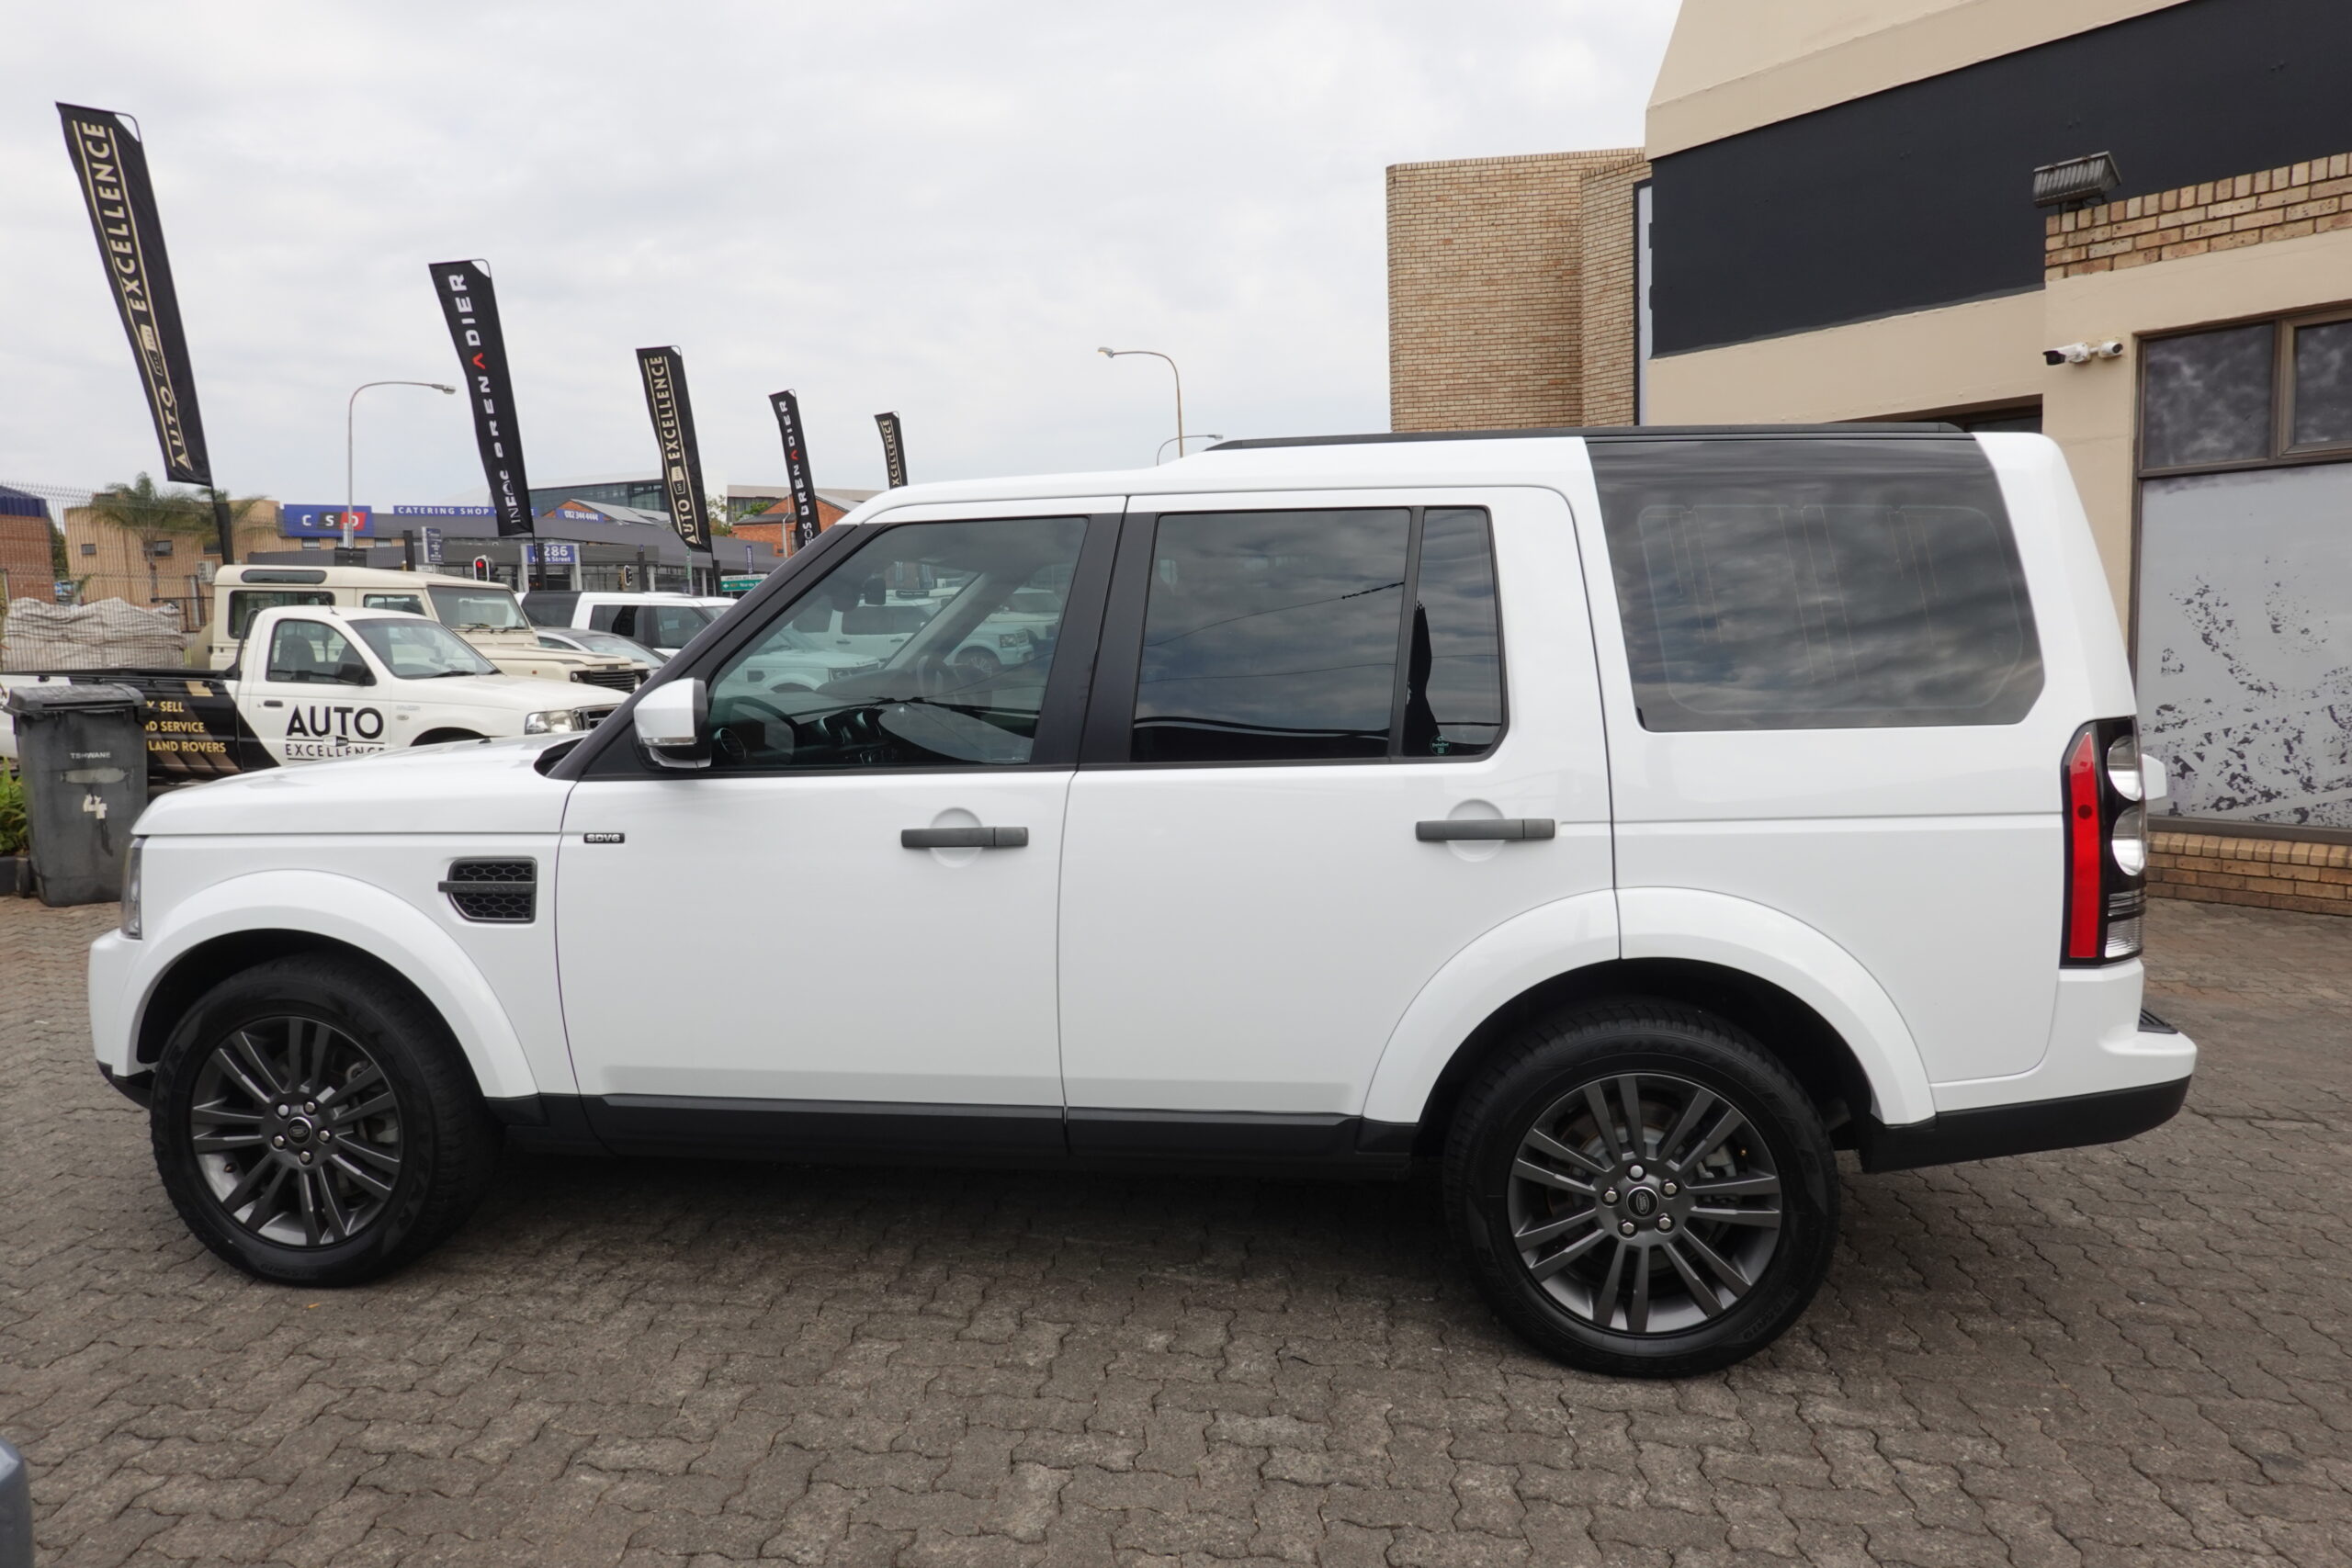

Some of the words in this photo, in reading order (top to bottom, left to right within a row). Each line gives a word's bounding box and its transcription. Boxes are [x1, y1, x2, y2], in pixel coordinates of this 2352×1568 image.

[82, 122, 148, 312] EXCELLENCE
[649, 355, 681, 460] EXCELLENCE
[160, 386, 190, 468] AUTO
[882, 419, 900, 486] XCELLENCE
[398, 506, 456, 515] CATERING
[677, 499, 698, 544] AUTO
[536, 546, 568, 557] 286
[160, 701, 185, 713] SELL
[286, 705, 384, 740] AUTO
[160, 721, 205, 733] SERVICE
[148, 740, 178, 751] LAND
[182, 741, 227, 753] ROVERS
